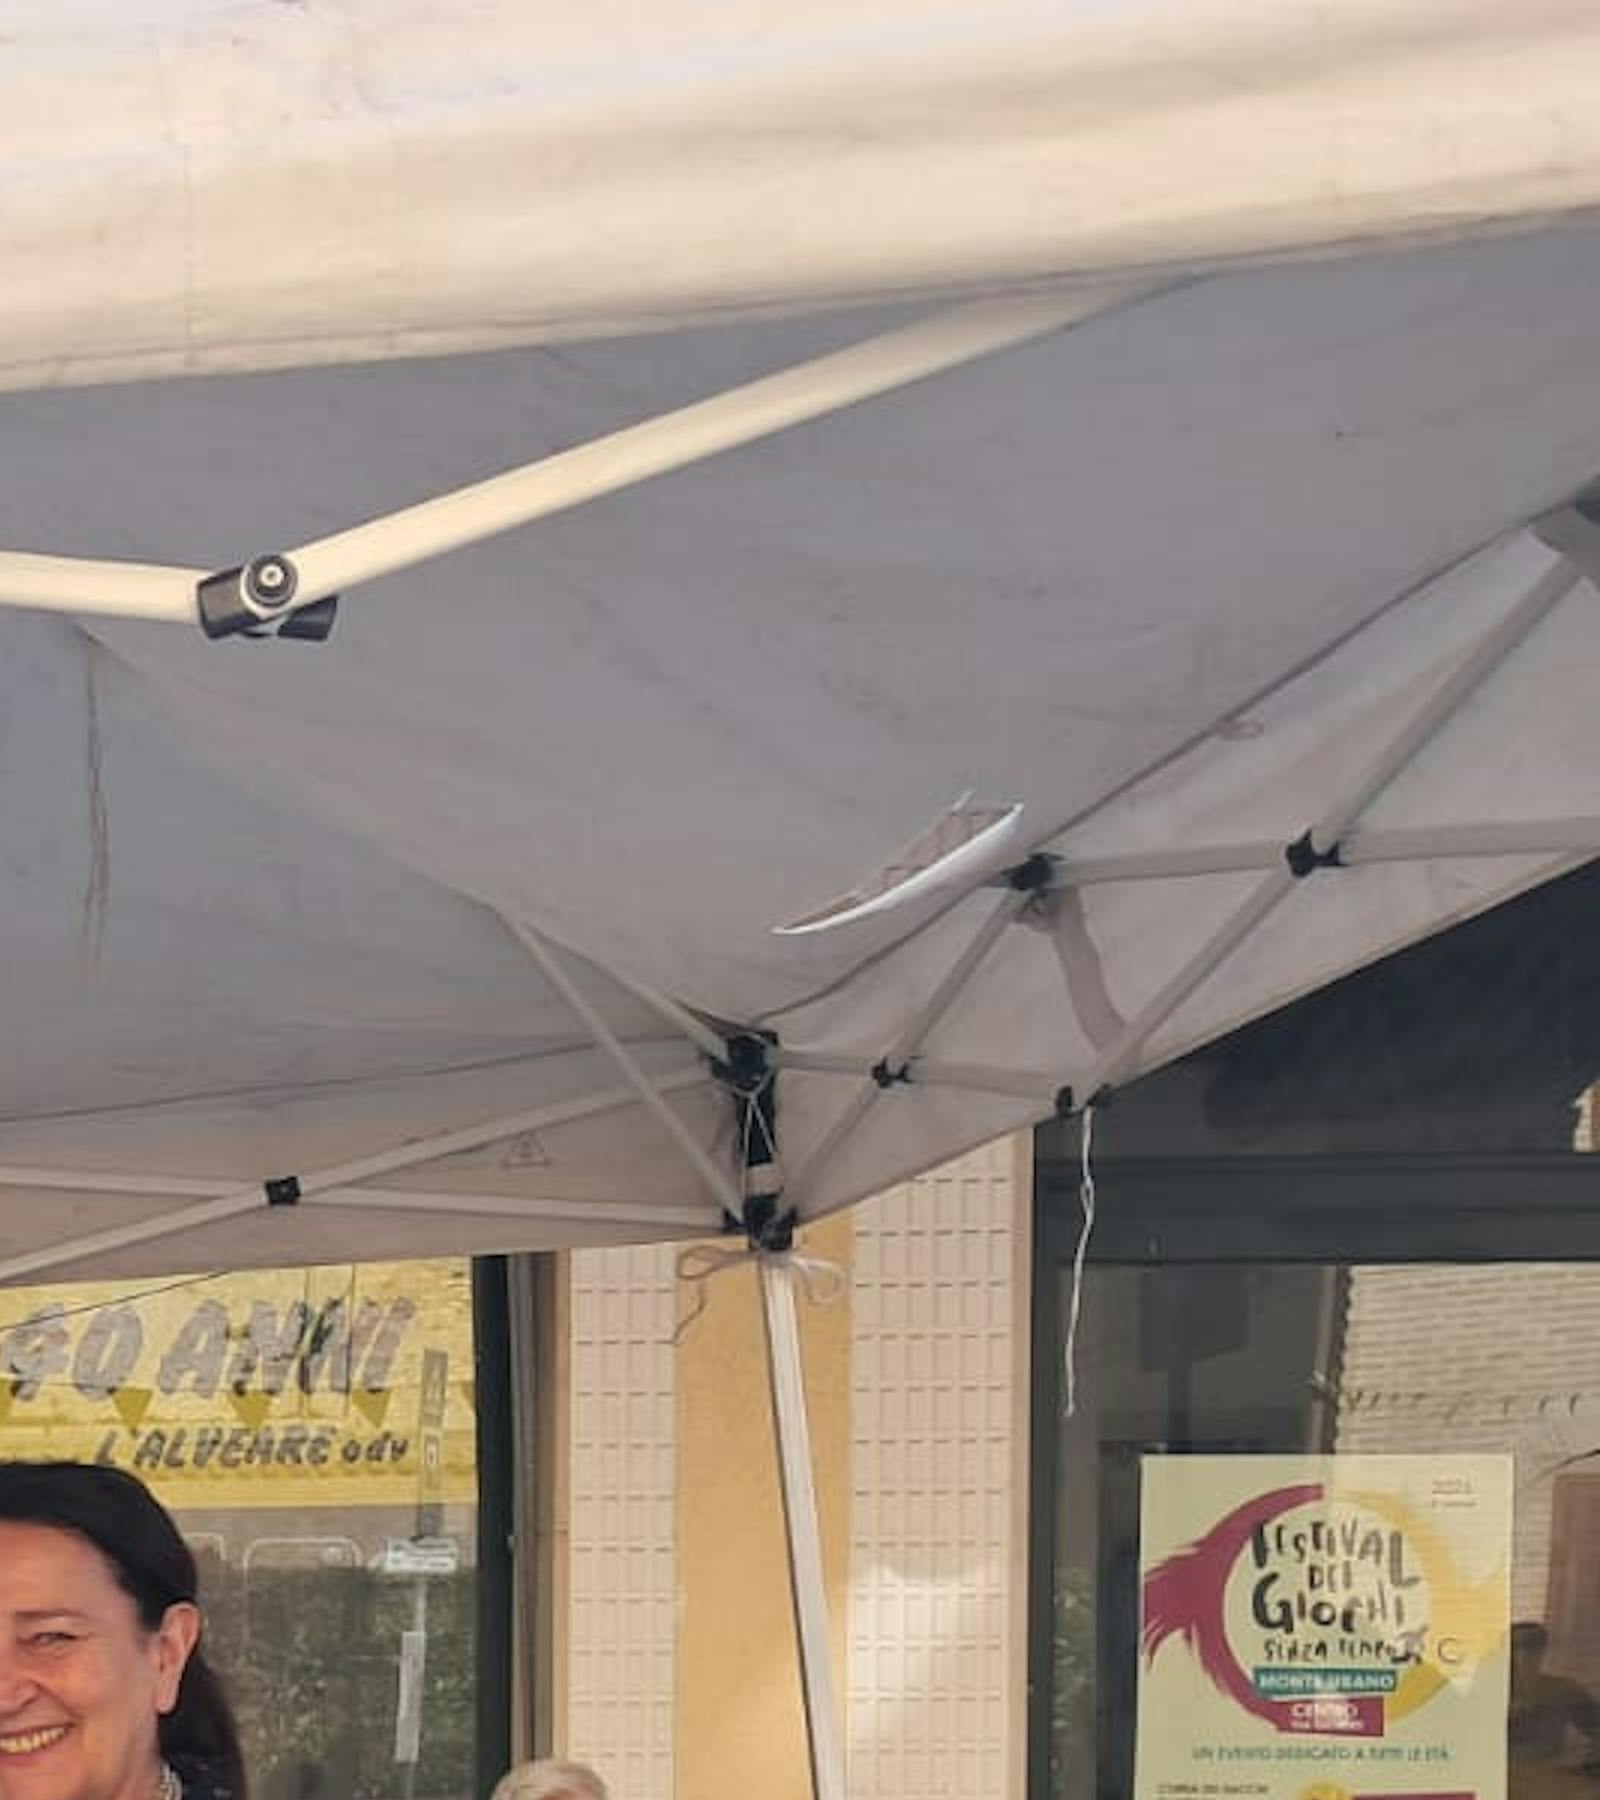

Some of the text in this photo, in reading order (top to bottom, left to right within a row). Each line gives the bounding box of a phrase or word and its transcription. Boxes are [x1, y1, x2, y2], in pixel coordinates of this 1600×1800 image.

[158, 1296, 417, 1398] ANNI
[1251, 1517, 1421, 1588] FESTIVAL
[1309, 1560, 1352, 1591] DEI
[1252, 1572, 1404, 1635] GIOCHI
